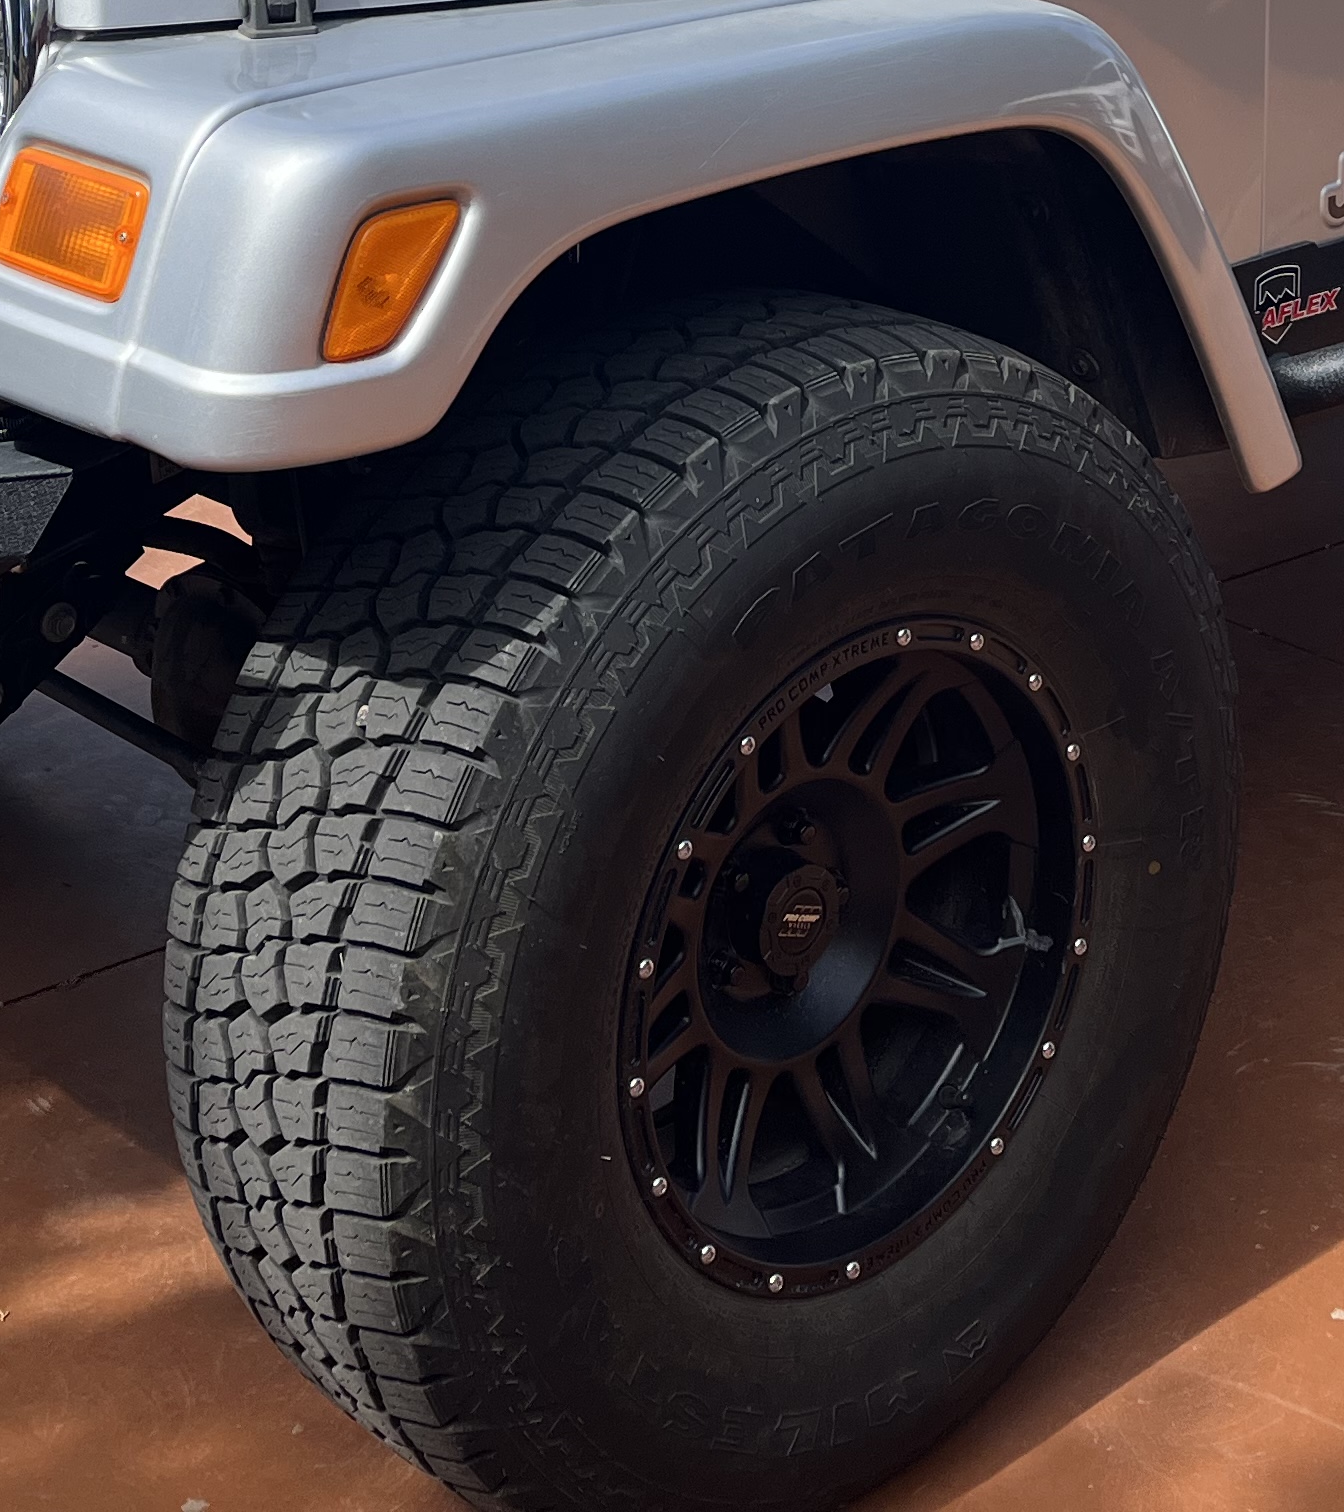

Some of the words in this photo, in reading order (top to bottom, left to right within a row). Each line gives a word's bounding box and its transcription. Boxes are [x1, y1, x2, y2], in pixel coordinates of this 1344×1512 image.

[758, 697, 786, 731] PRO
[788, 662, 828, 702] COMP
[832, 631, 889, 667] XTREME
